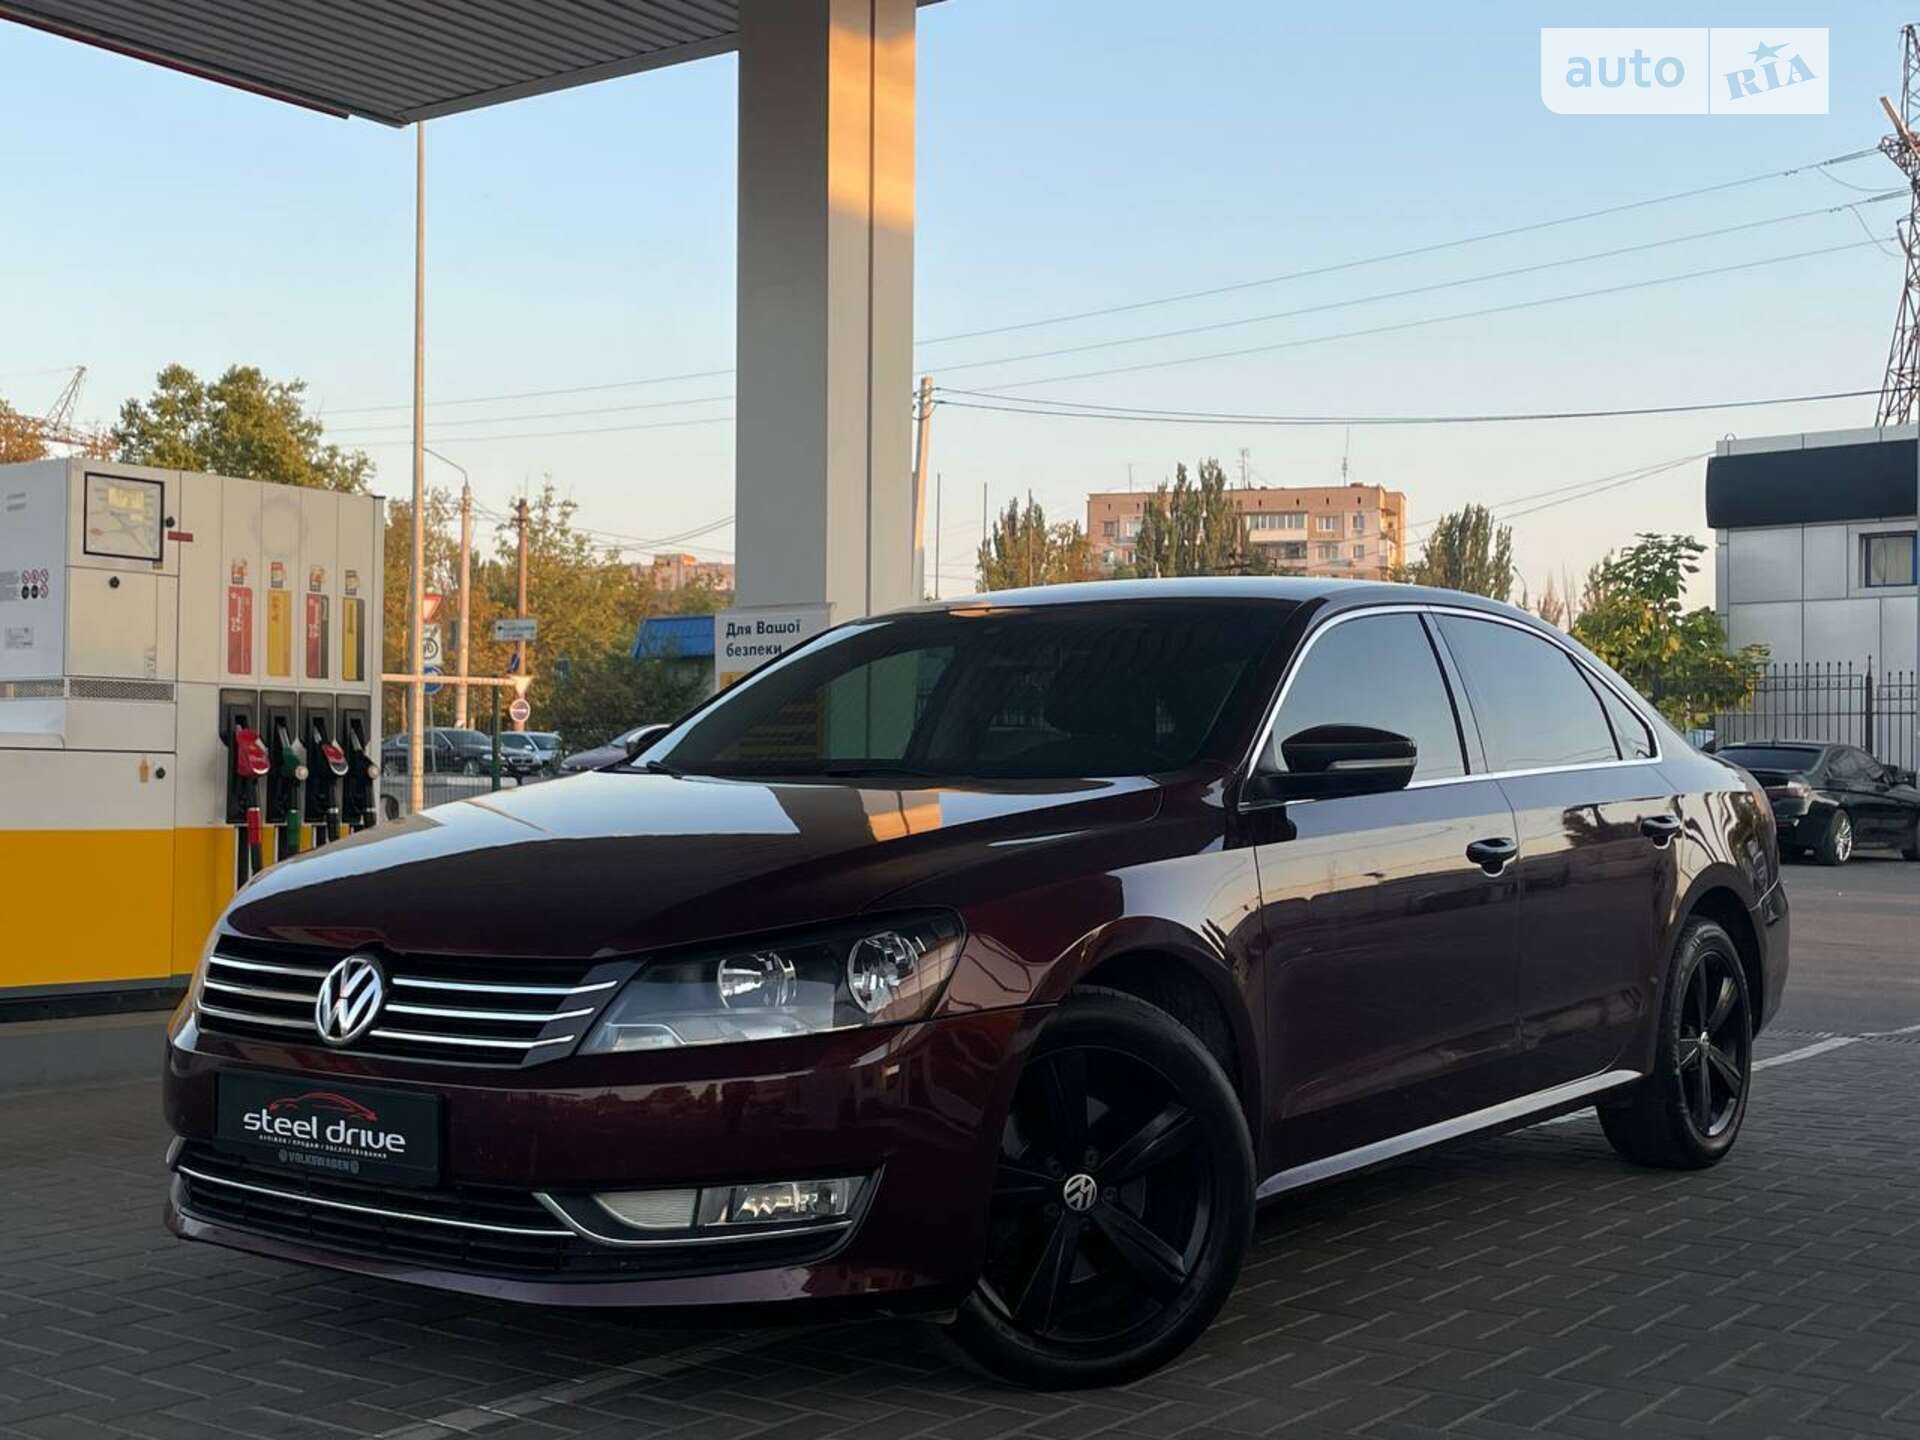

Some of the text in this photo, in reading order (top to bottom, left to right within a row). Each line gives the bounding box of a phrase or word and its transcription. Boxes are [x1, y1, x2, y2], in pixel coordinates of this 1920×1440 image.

[726, 618, 801, 638] Для Вашої
[726, 643, 782, 657] безпеки
[243, 1108, 317, 1139] steel
[325, 1119, 406, 1153] drive
